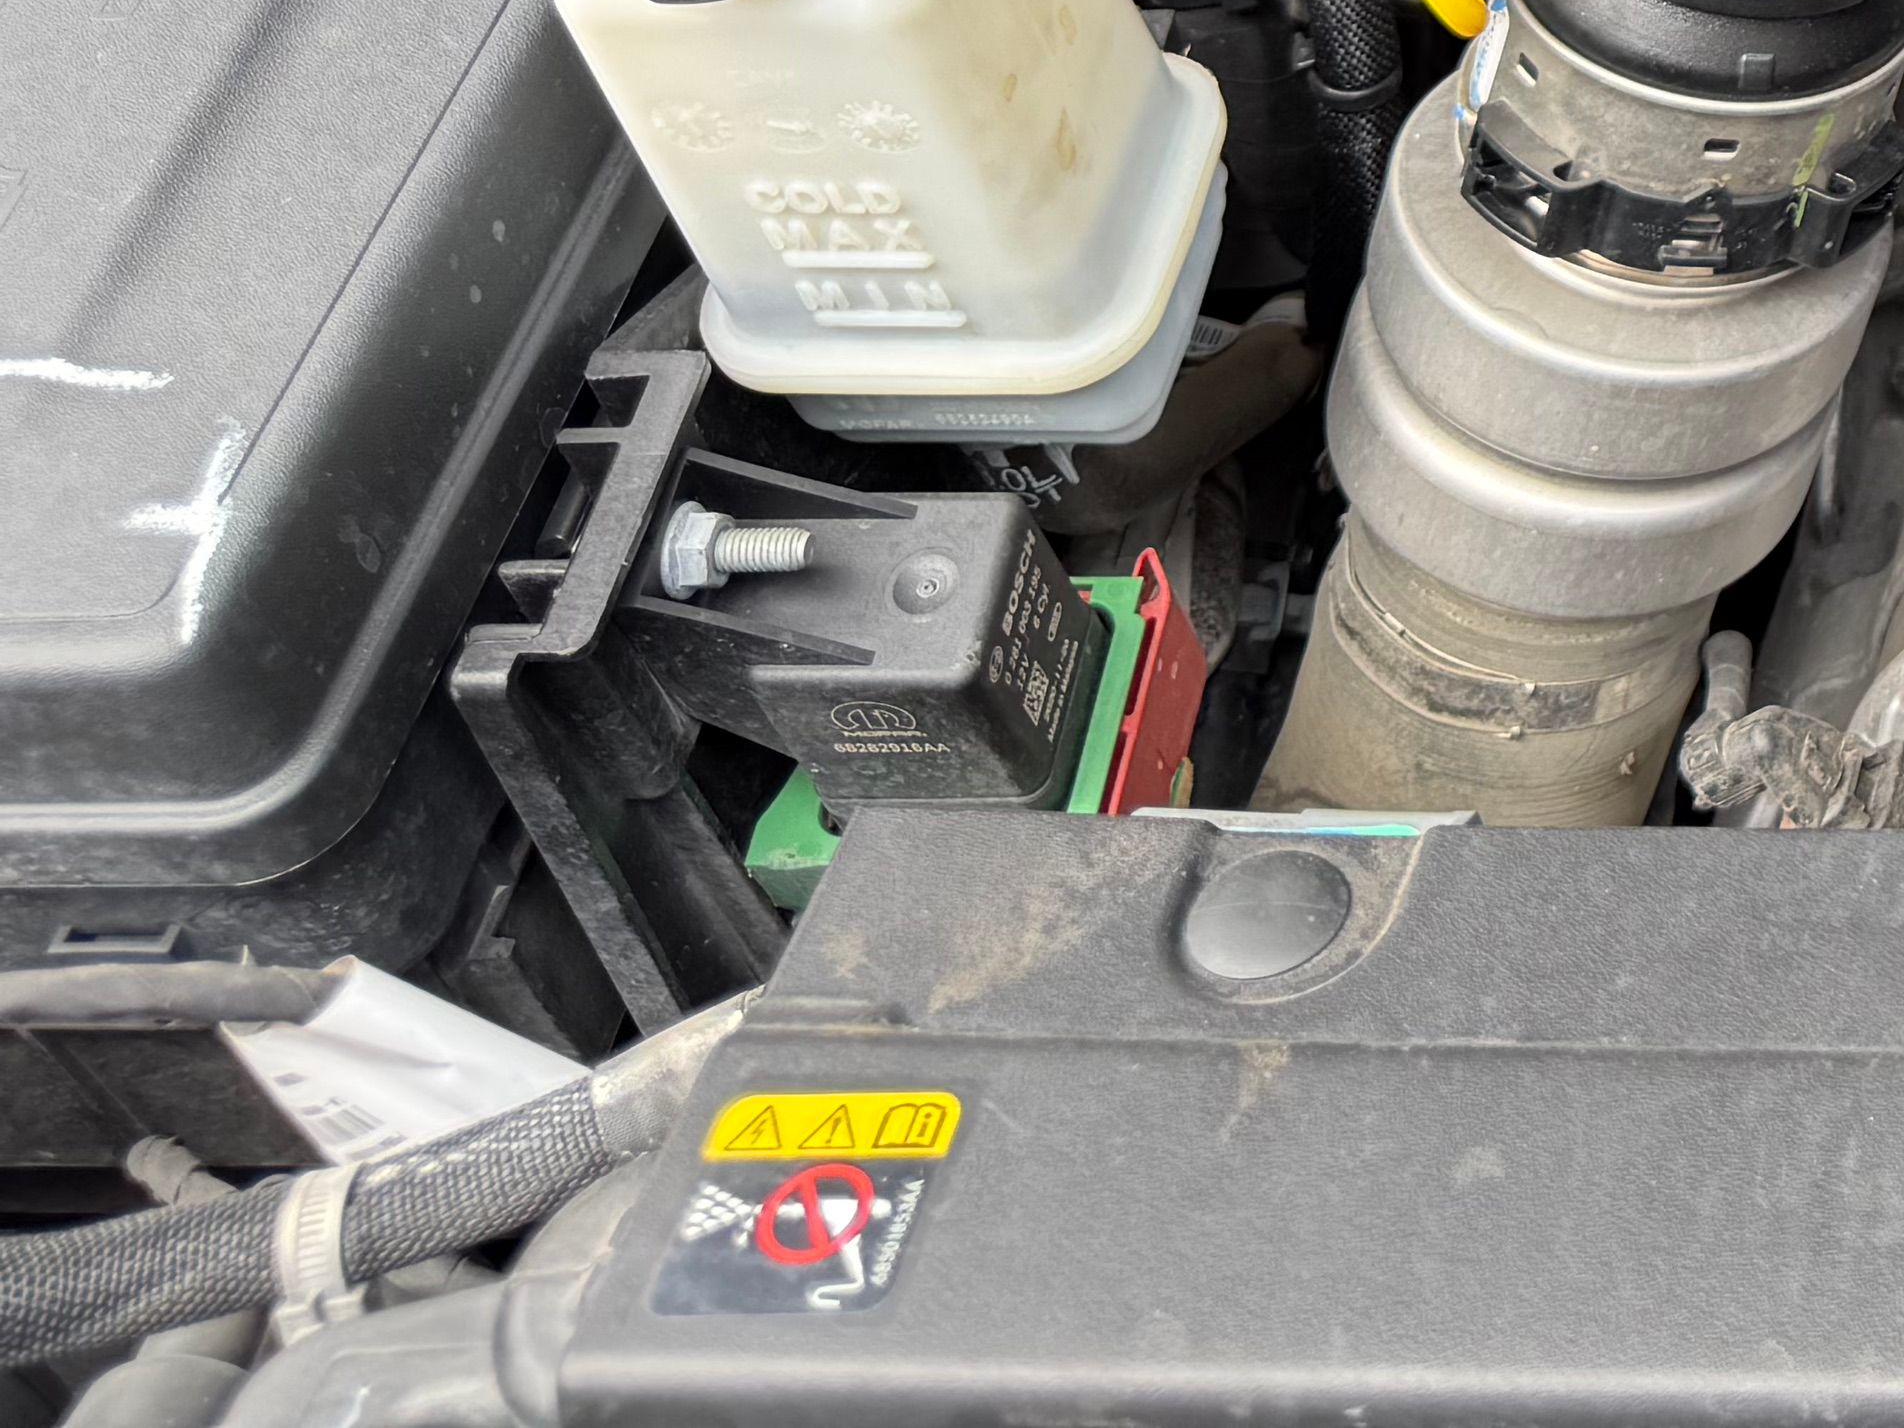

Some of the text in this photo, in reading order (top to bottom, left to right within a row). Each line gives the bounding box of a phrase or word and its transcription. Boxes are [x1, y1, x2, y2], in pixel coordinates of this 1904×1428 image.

[744, 181, 901, 215] COLD
[760, 218, 924, 251] MAX
[795, 279, 952, 312] MIN
[1002, 528, 1036, 636] BOSCH
